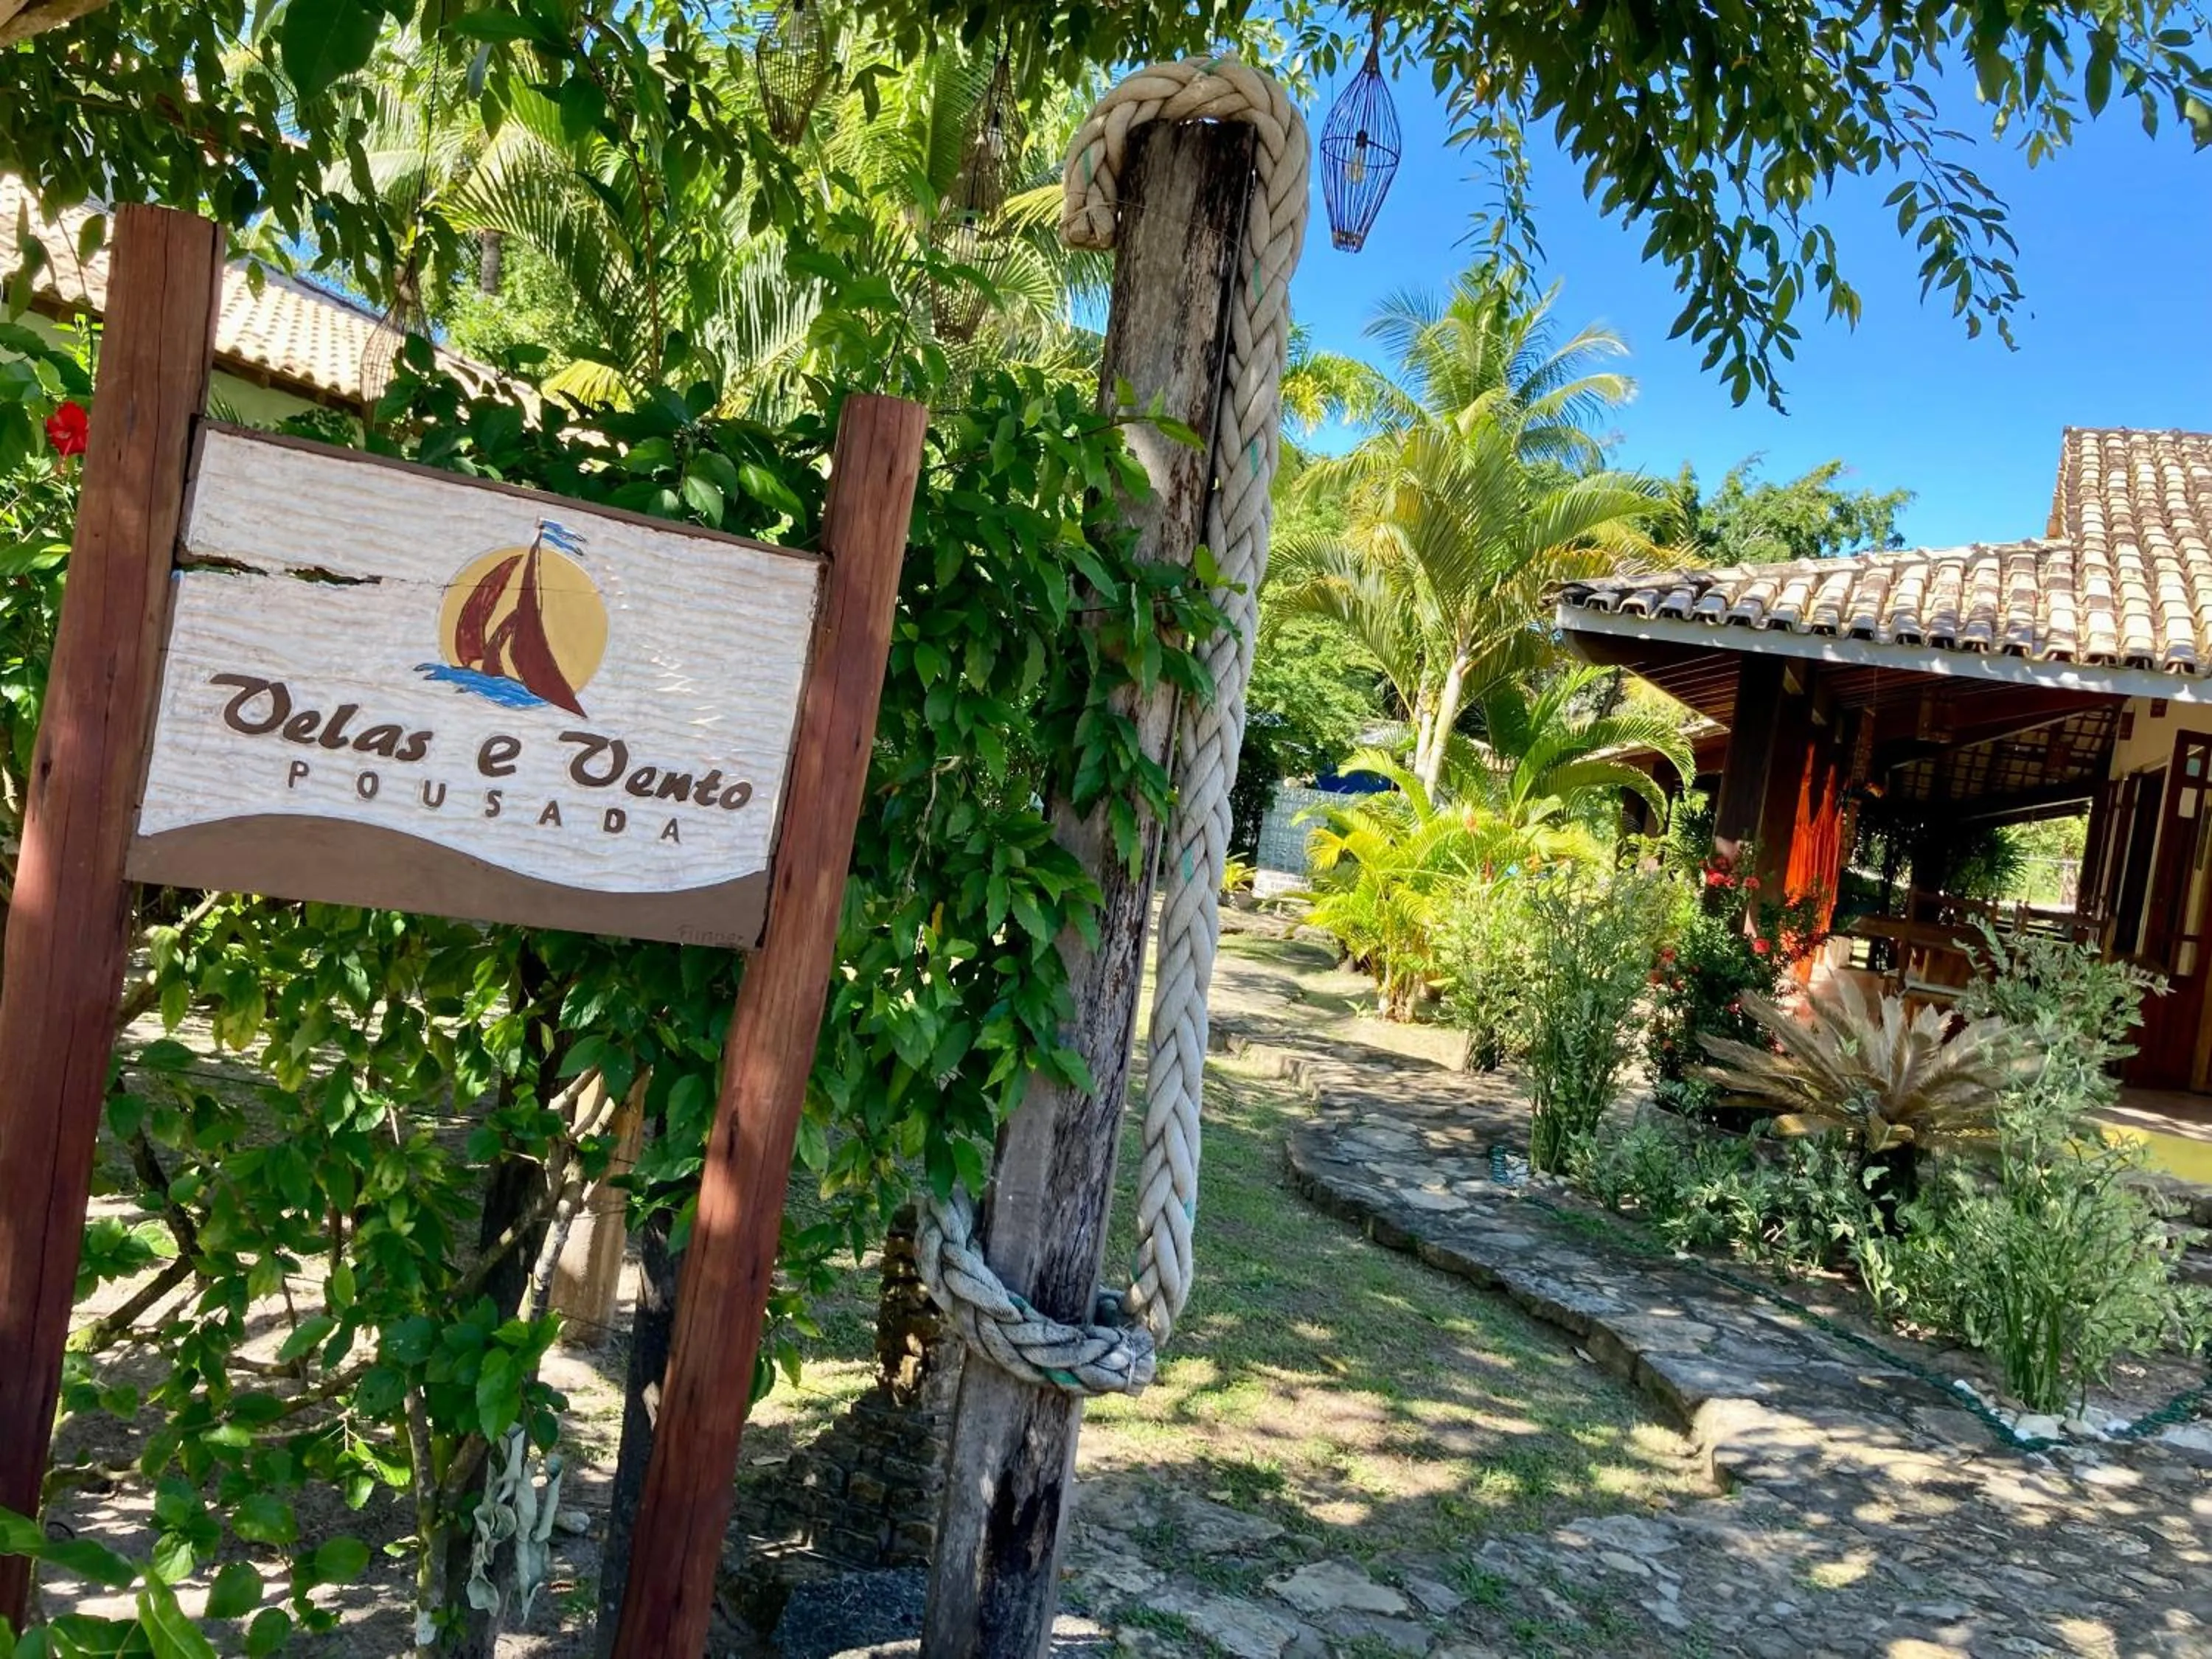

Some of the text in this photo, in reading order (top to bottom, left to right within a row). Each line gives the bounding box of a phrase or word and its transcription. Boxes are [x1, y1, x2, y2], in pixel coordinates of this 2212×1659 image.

[209, 672, 753, 810] Velas e Vento
[288, 759, 681, 845] POUSADA
